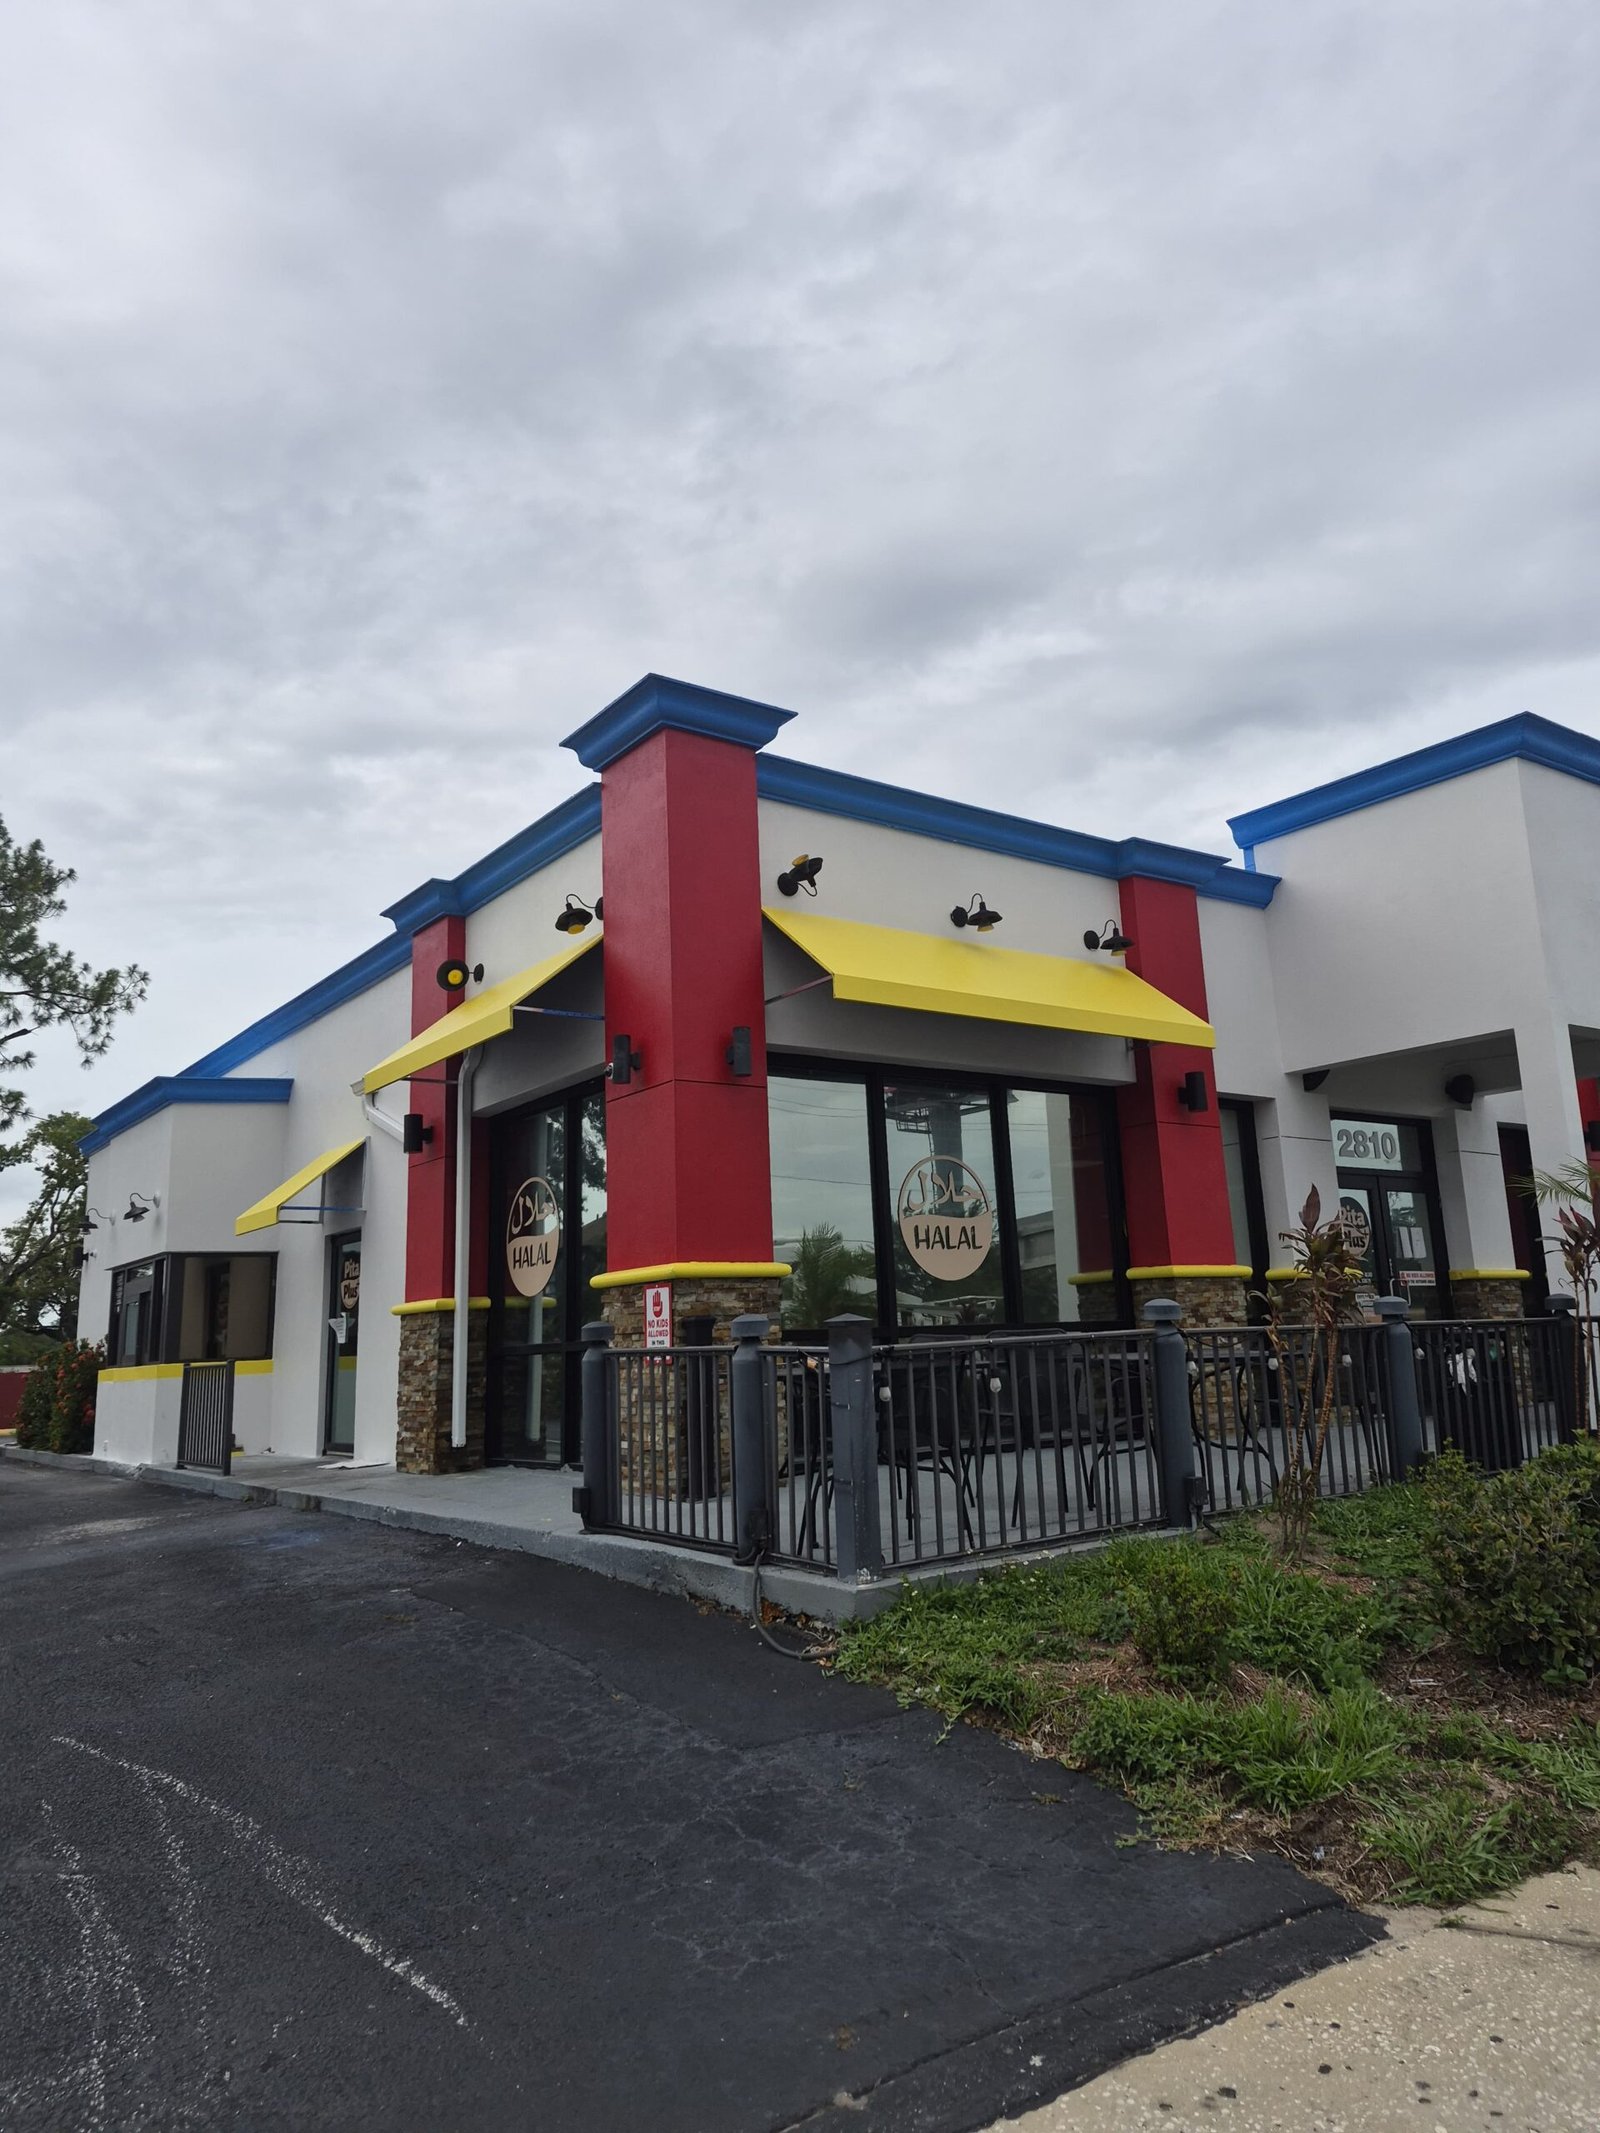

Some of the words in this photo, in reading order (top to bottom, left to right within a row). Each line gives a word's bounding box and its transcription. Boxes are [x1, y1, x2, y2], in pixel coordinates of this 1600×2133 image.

[1337, 1128, 1397, 1160] 2810
[906, 1169, 983, 1211] حلال
[914, 1224, 983, 1250] HALAL
[344, 1258, 360, 1279] Pita
[513, 1241, 551, 1270] HALAL
[648, 1320, 655, 1329] NO
[656, 1318, 669, 1329] KIDS
[648, 1329, 669, 1338] ALLOWED
